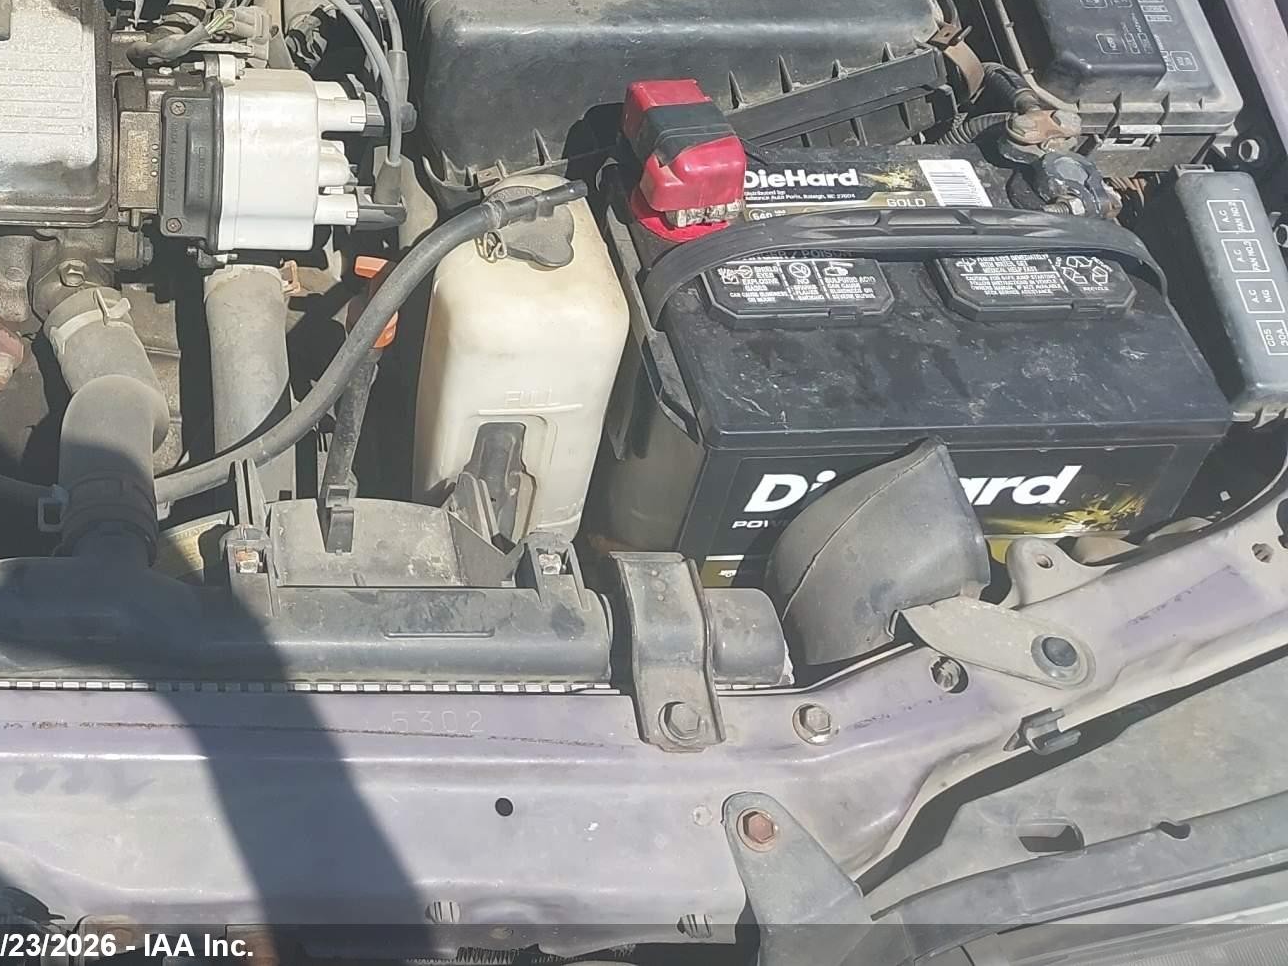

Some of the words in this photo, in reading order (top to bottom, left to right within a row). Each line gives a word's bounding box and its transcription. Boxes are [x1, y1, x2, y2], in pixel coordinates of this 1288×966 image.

[744, 168, 859, 188] DieHard
[887, 197, 926, 207] GOLD
[504, 388, 560, 408] FULL
[392, 710, 484, 733] 5302
